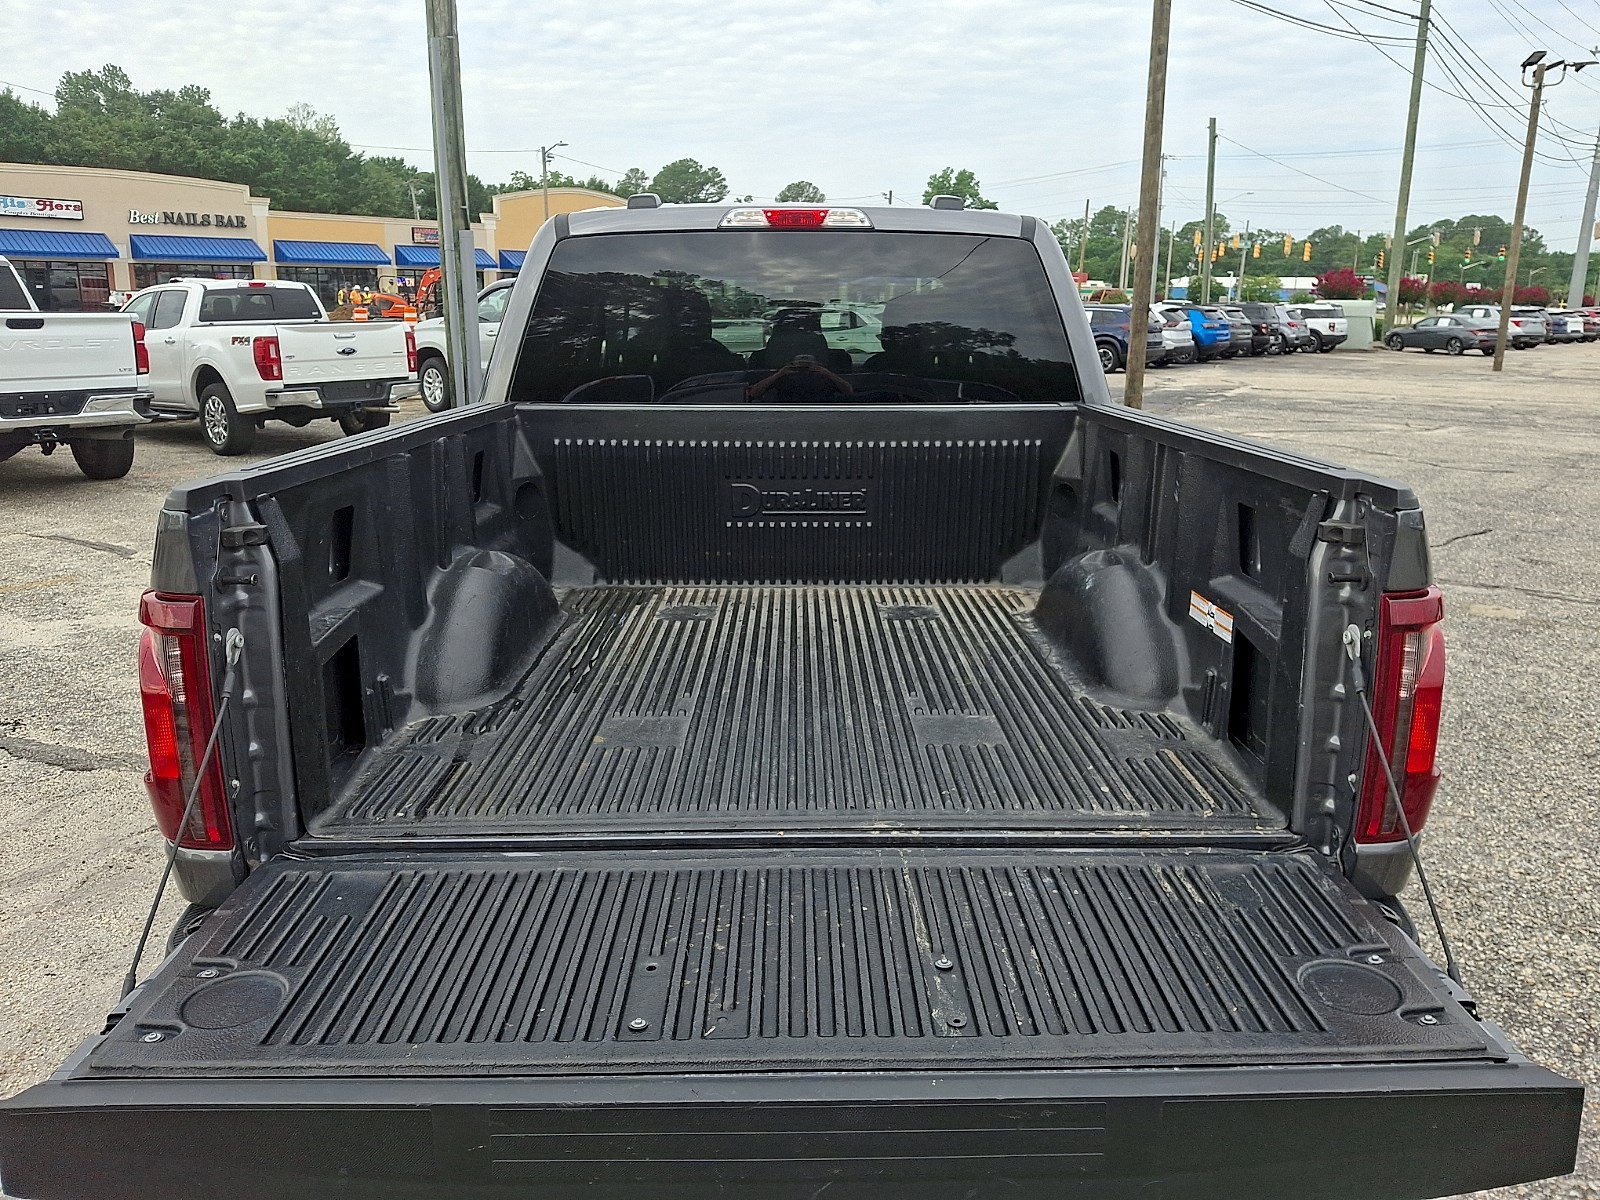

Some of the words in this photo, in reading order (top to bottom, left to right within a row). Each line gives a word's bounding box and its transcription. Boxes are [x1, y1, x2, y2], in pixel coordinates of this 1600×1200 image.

[36, 199, 82, 212] Hers
[128, 209, 160, 224] Best
[162, 211, 212, 227] NAILS
[213, 214, 247, 228] BAR
[232, 336, 250, 346] FX4
